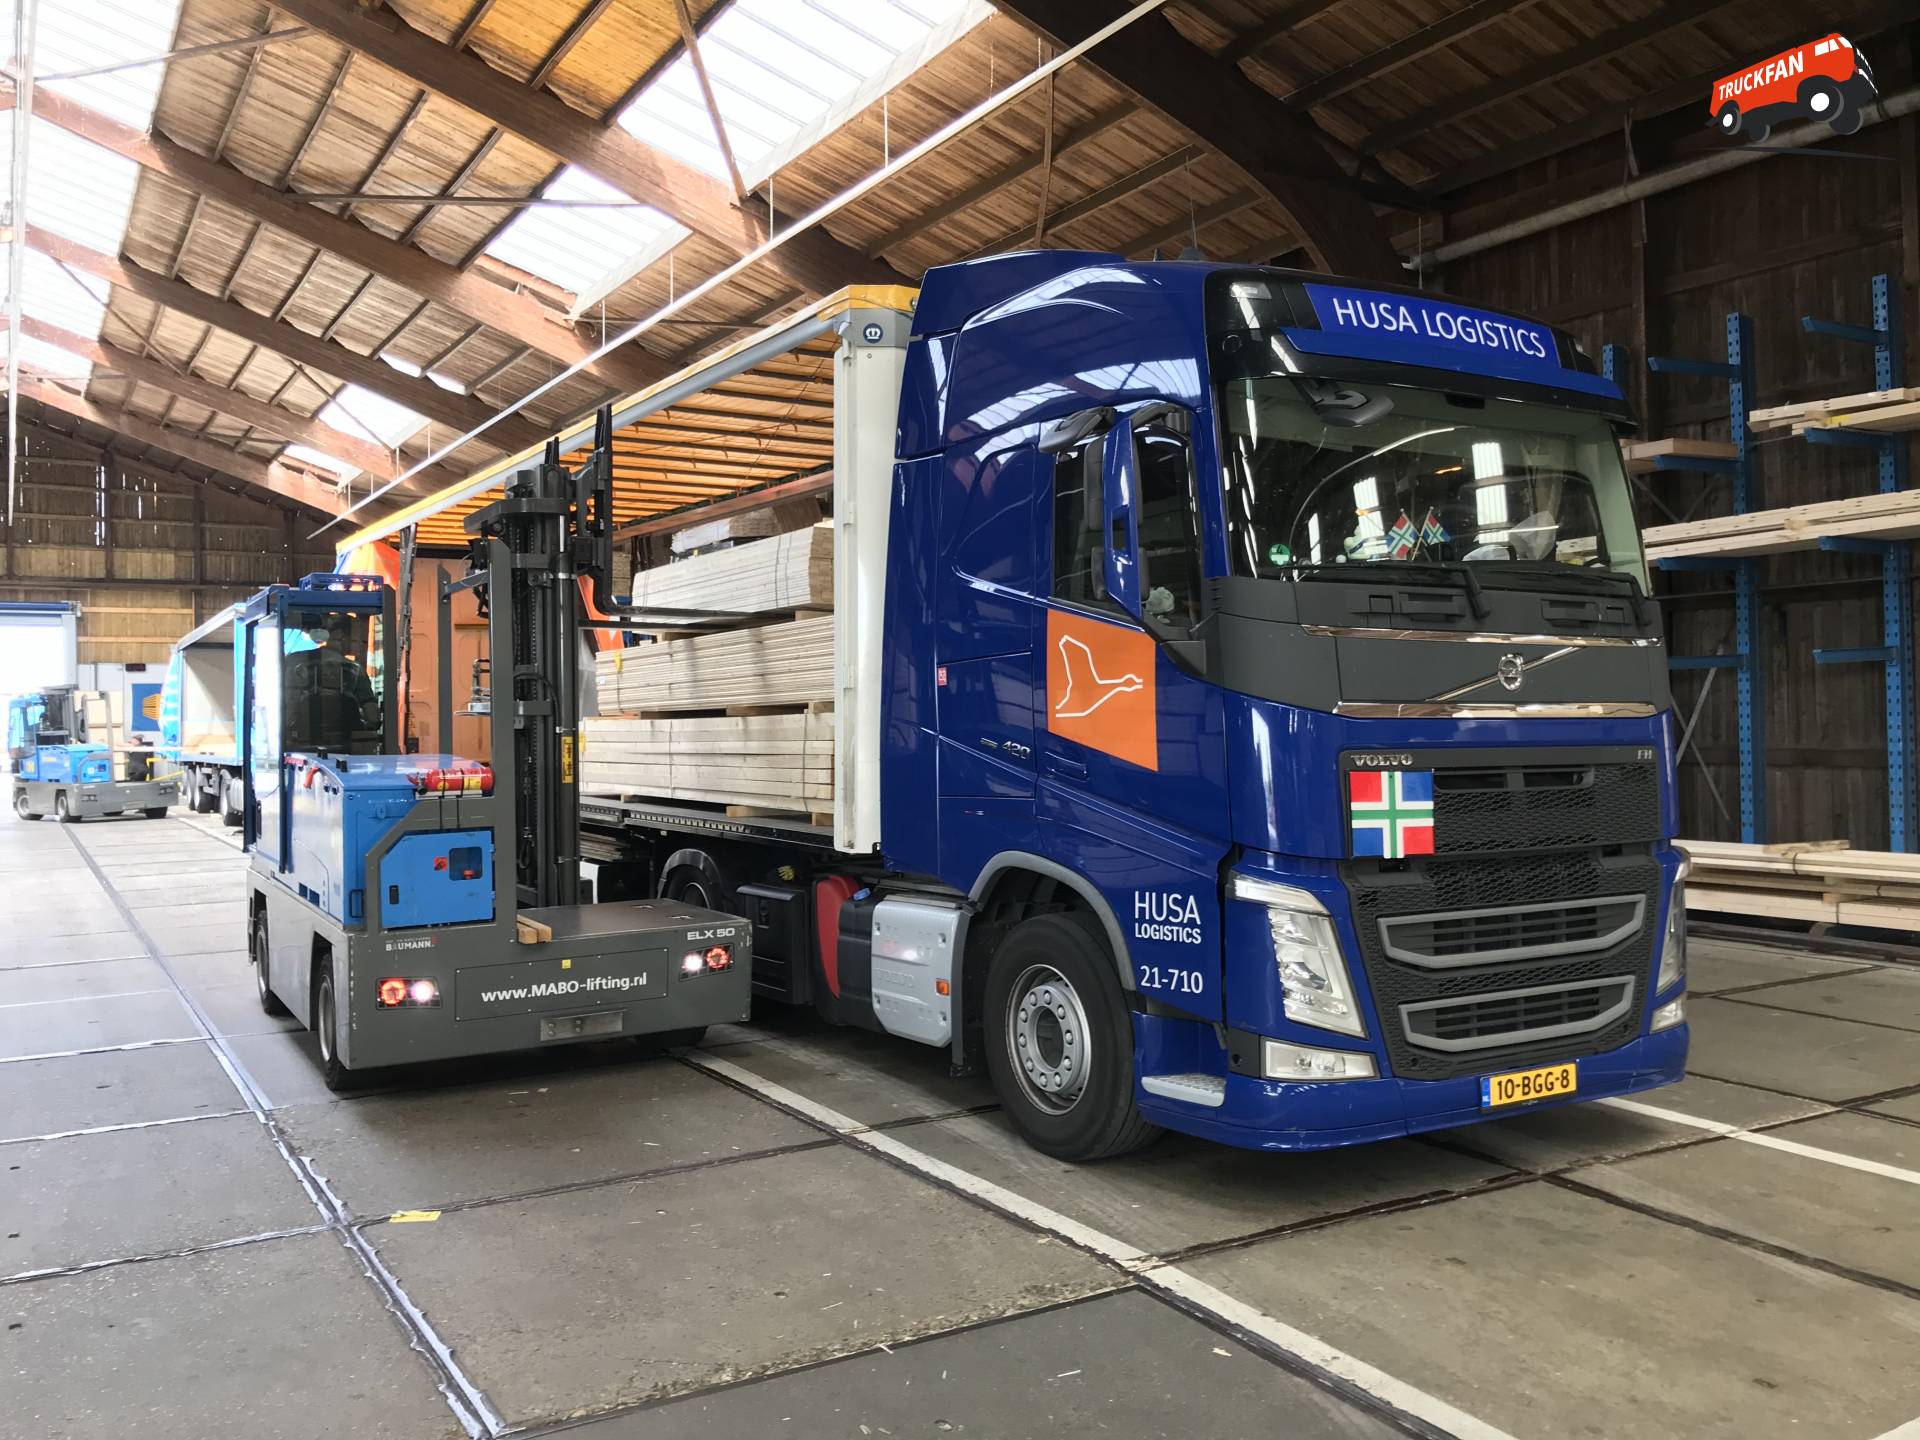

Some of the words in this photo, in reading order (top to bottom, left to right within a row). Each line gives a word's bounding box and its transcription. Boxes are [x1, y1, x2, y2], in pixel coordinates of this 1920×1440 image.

[1333, 298, 1419, 334] HUSA
[1421, 309, 1546, 358] LOGISTICS
[1350, 754, 1413, 767] VOLVO
[1134, 890, 1202, 925] HUSA
[687, 929, 715, 941] ELX
[716, 927, 736, 938] 50
[1134, 922, 1202, 945] LOGISTICS
[480, 971, 648, 1003] www.MABO-lifting.nl
[1139, 964, 1204, 994] 21-710
[1497, 1068, 1570, 1101] 10-BGG-8
